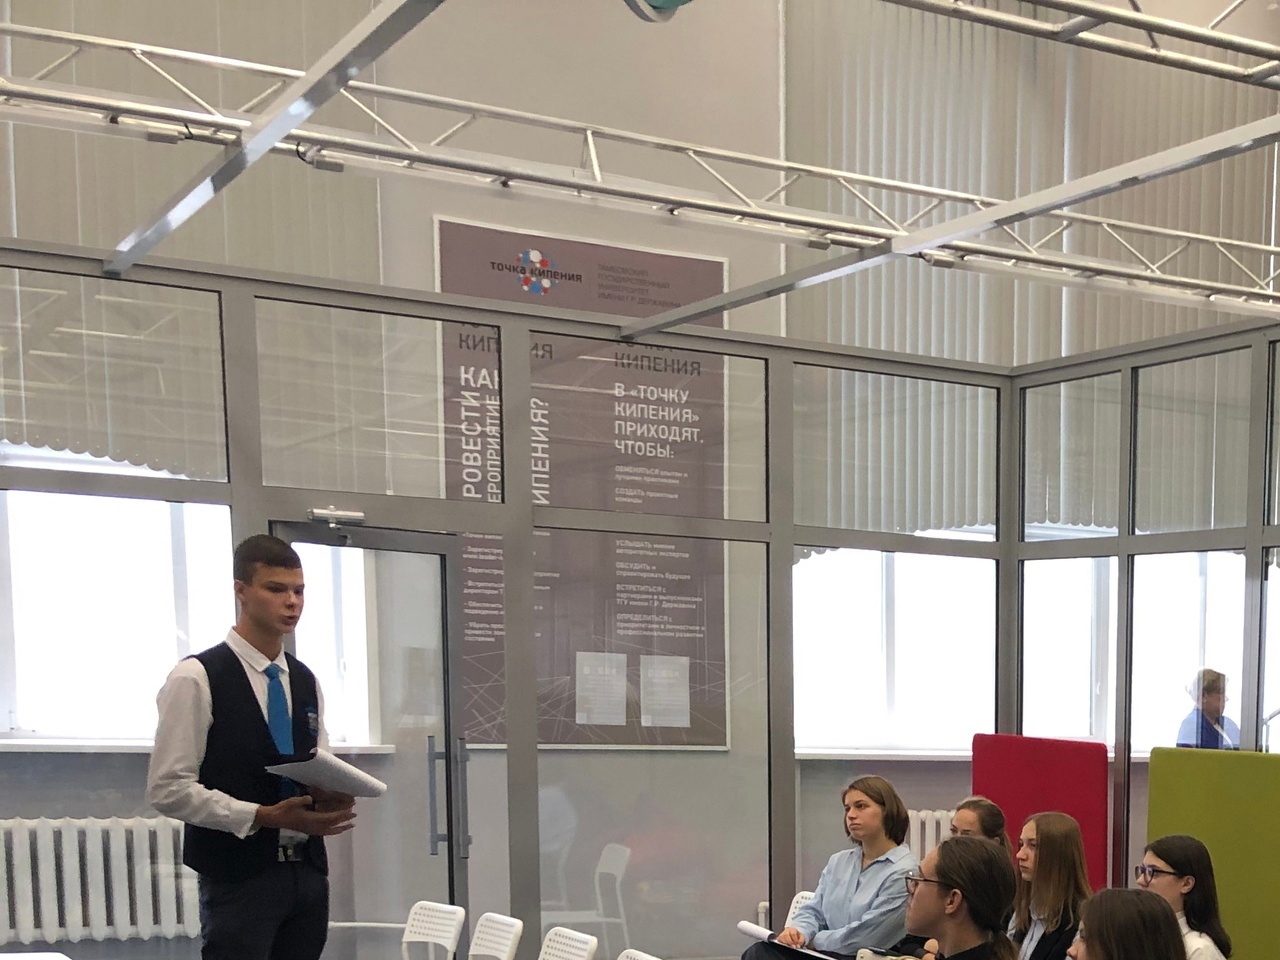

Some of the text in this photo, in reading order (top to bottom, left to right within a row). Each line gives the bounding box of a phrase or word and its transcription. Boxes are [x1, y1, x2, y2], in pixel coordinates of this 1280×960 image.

[530, 267, 583, 283] кипения
[614, 352, 701, 376] КИПЕНИЯ
[614, 383, 625, 397] В
[461, 391, 483, 498] РОВЕСТИ
[486, 395, 501, 503] ЕРОПРИЯТИЕ
[530, 397, 550, 504] ИПЕНИЯ?
[615, 439, 675, 458] ЧТОБЫ:
